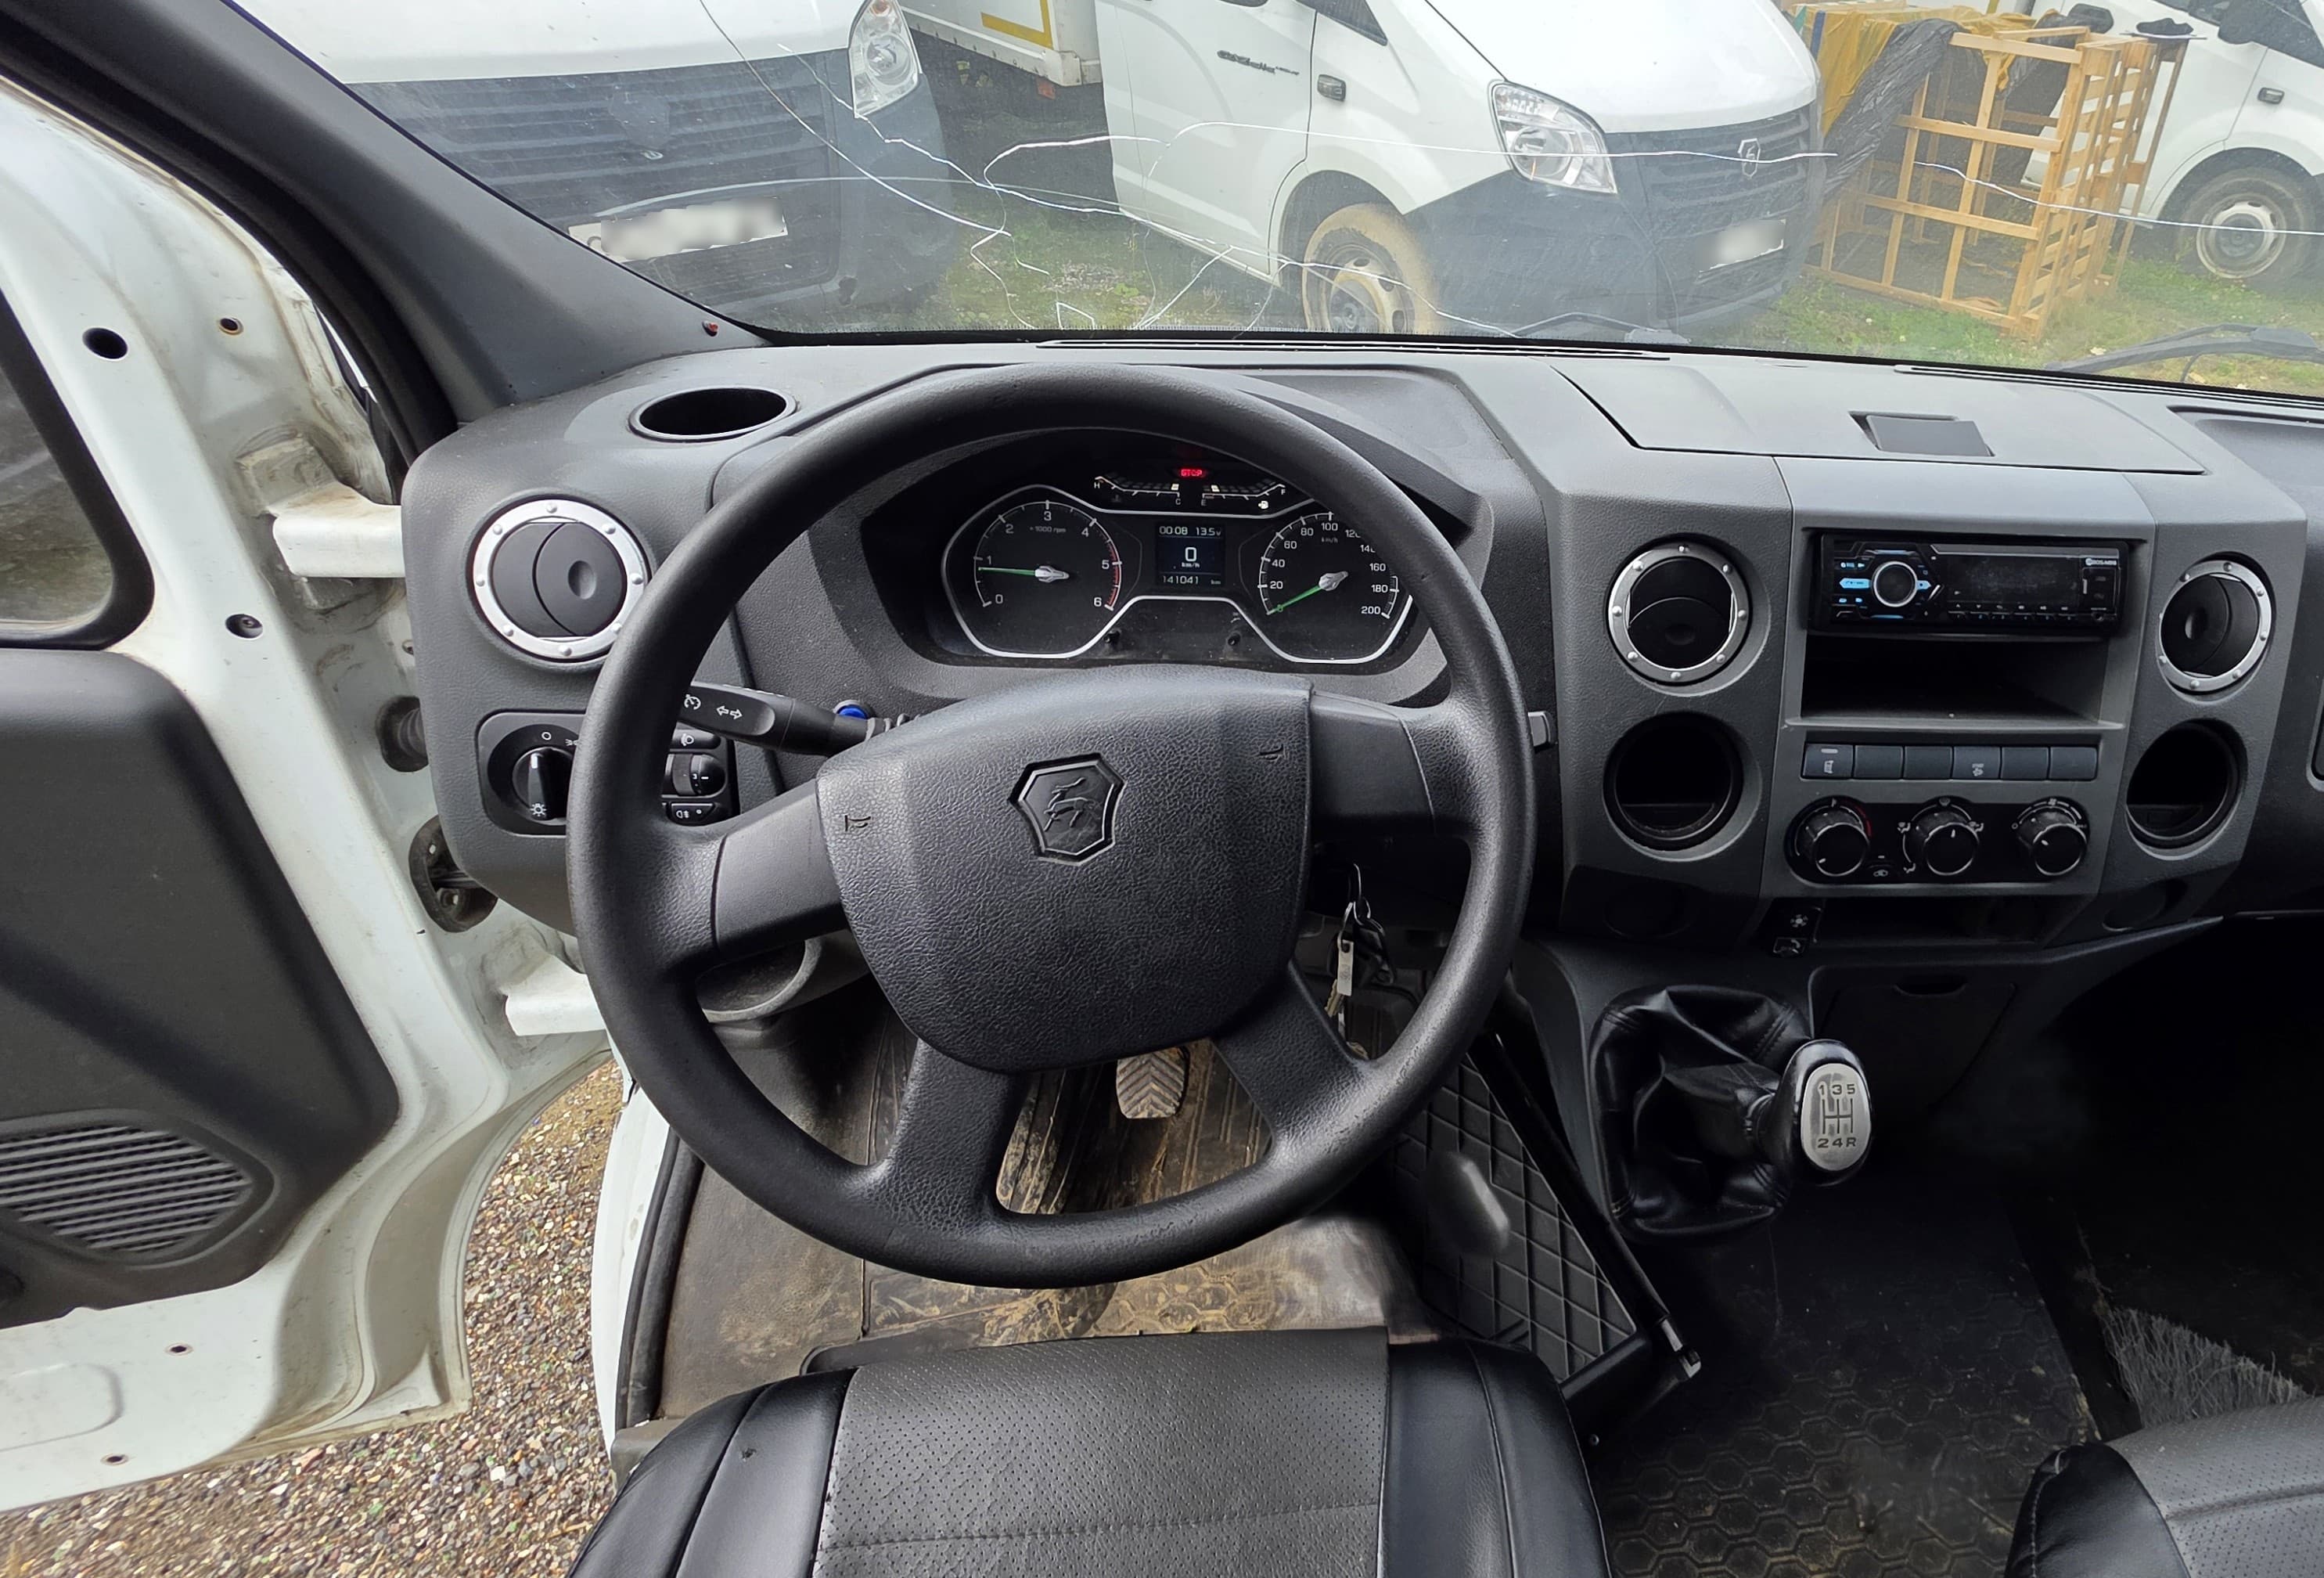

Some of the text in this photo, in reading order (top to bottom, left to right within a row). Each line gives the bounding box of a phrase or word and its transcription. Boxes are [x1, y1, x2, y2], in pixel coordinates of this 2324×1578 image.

[1044, 511, 1052, 521] 3
[1006, 524, 1014, 534] 2
[1321, 522, 1338, 531] 100
[1081, 528, 1089, 537] 4
[1301, 528, 1314, 537] 80
[1284, 540, 1297, 549] 60
[1185, 546, 1197, 562] 0
[987, 556, 992, 565] 1
[1102, 560, 1110, 570] 5
[1272, 559, 1286, 568] 40
[1369, 562, 1386, 572] 160
[1163, 575, 1199, 585] 141041
[1270, 581, 1283, 590] 20
[1371, 584, 1388, 594] 180
[995, 594, 1004, 604] 0
[1094, 597, 1102, 607] 6
[1361, 606, 1382, 615] 200
[1819, 1083, 1856, 1096] 1 3 5
[1817, 1137, 1857, 1149] 2 4 R
